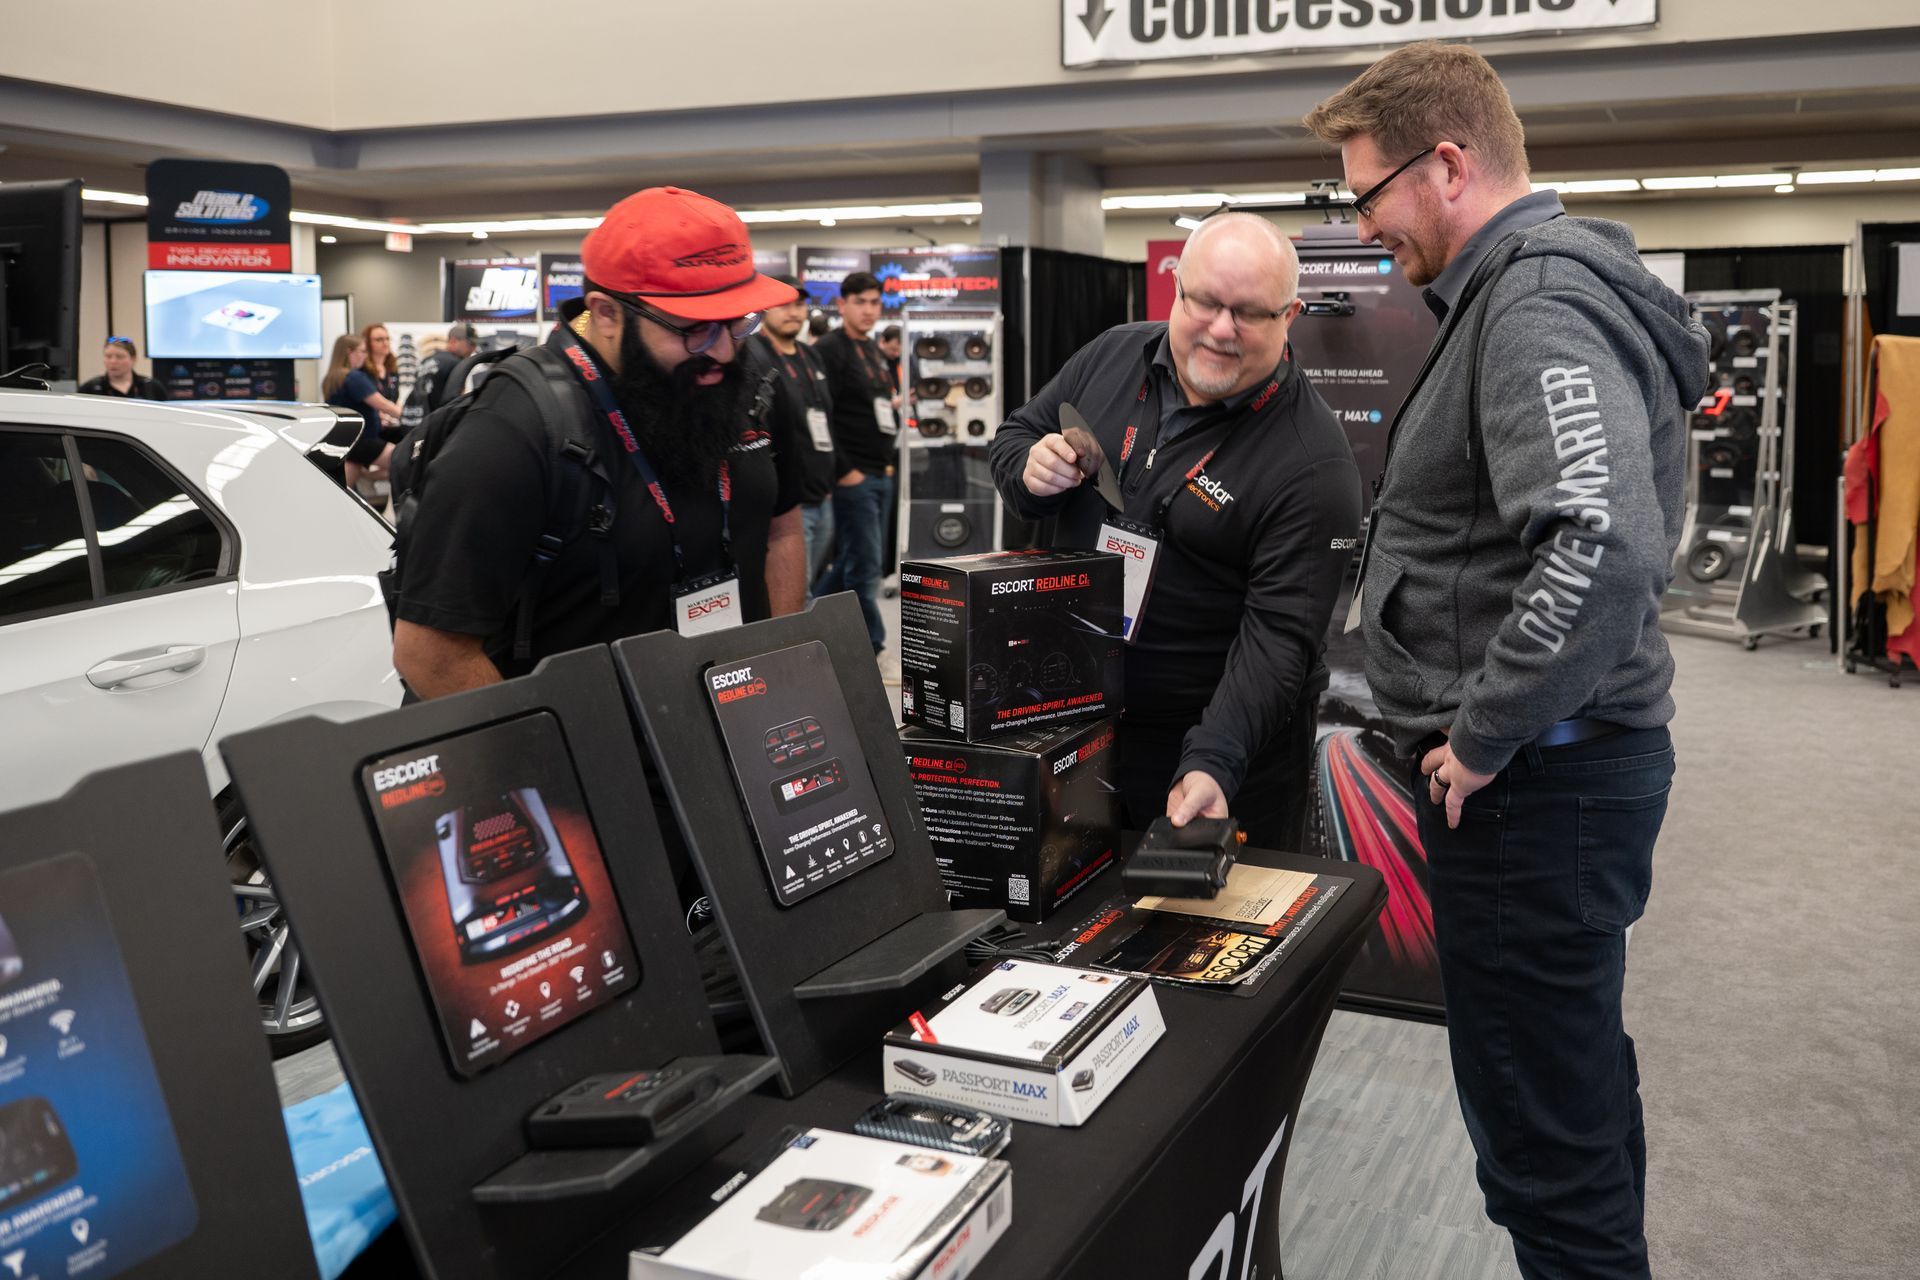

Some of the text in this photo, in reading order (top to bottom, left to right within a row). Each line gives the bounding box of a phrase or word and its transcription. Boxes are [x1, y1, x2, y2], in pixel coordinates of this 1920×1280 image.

[167, 255, 272, 267] INNOVATION
[1323, 369, 1338, 378] THE
[1338, 369, 1358, 378] ROAD
[1358, 369, 1383, 378] AHEAD
[1345, 410, 1369, 422] MAX
[1540, 365, 1610, 533] SMARTER
[1106, 539, 1145, 560] EXPO
[1108, 535, 1147, 551] MASTERTECH
[902, 573, 922, 583] ESCORT
[991, 578, 1035, 595] ESCORT
[1036, 575, 1076, 591] REDLINE
[1518, 530, 1604, 654] DRIVE
[688, 596, 730, 619] EXPO
[711, 667, 753, 690] ESCORT
[997, 710, 1012, 720] THE
[1012, 704, 1041, 717] DRIVING
[1067, 692, 1103, 706] AWAKENED
[990, 718, 1027, 731] Game-Changing
[1057, 707, 1081, 718] Unmatched
[913, 757, 944, 768] REDLINE
[1054, 750, 1078, 775] ESCORT
[373, 755, 440, 792] ESCORT
[917, 773, 959, 784] PROTECTION.
[960, 778, 1001, 788] PERFECTION.
[973, 790, 1004, 799] game-changing
[999, 824, 1021, 832] Dual-Band
[788, 834, 799, 844] THE
[992, 842, 1015, 850] Technology
[1075, 921, 1106, 944] REDLINE
[1201, 935, 1266, 980] ESCORT
[1049, 984, 1072, 1001] MAX
[1092, 1029, 1125, 1071] PASSPORT
[1122, 1015, 1140, 1039] MAX
[942, 1068, 1048, 1099] PASSPORT MAX
